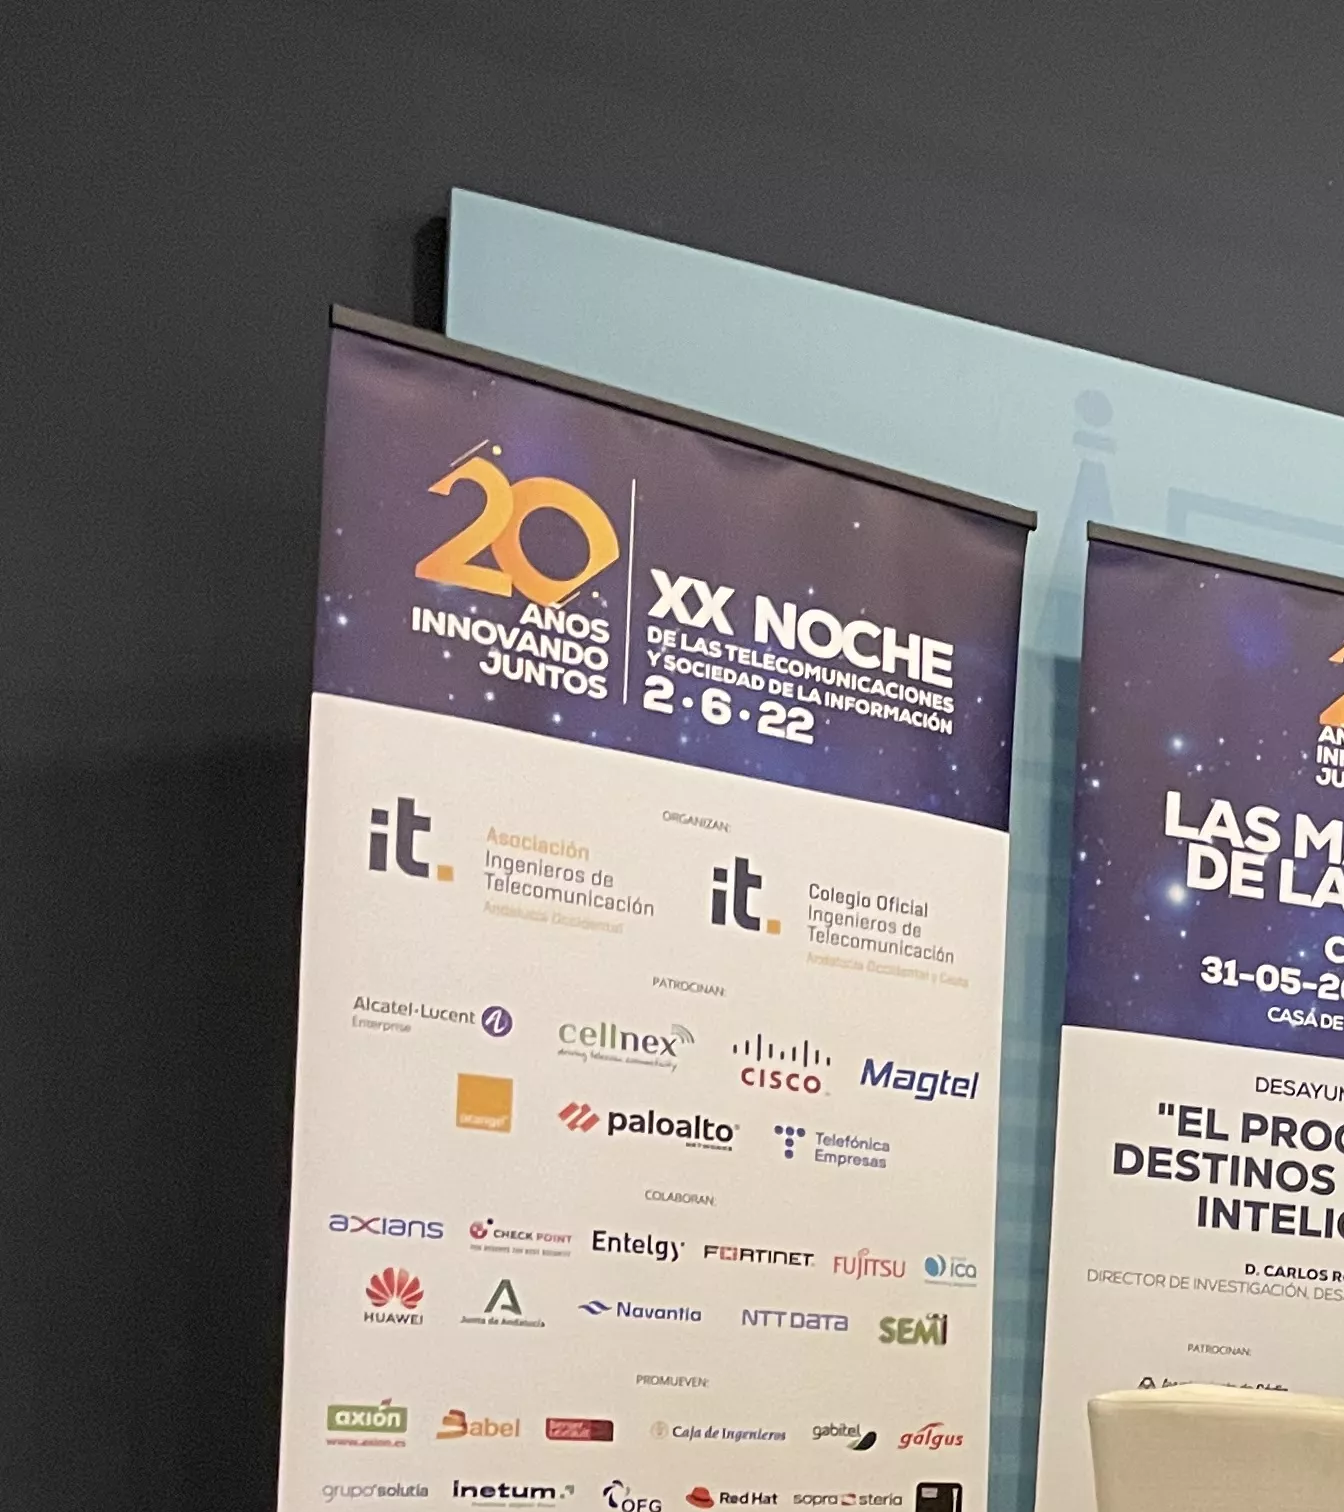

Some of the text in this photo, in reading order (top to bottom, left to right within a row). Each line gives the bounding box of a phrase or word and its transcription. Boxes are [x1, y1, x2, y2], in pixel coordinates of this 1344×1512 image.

[415, 456, 620, 608] 20
[412, 606, 609, 671] INNOVANDO
[519, 601, 611, 645] AÑOS
[648, 568, 954, 688] XX NOCHE
[479, 650, 608, 700] JUNTOS
[647, 626, 955, 713] DE LAS TELECOMUNICACIONES
[646, 648, 954, 735] Y SOCIEDAD DE LA INFORMACIÓN
[1164, 790, 1281, 854] LAS
[486, 827, 591, 860] Asociación
[485, 850, 614, 888] Ingenieros de
[1187, 842, 1264, 900] DE
[484, 872, 655, 917] Telecomunicación
[808, 883, 929, 918] Colegio Oficial
[808, 905, 922, 938] Ingenieros de
[807, 925, 954, 964] Telecomunicación
[1267, 1006, 1318, 1028] CASA
[1321, 1014, 1344, 1031] DE
[558, 1022, 678, 1057] cellnex
[740, 1066, 822, 1093] CISCO
[860, 1058, 979, 1101] Magtel
[607, 1109, 734, 1142] paloalto
[1158, 1102, 1229, 1141] "EL
[815, 1132, 890, 1153] Telefónica
[815, 1149, 887, 1168] Empresas
[1112, 1142, 1336, 1196] DESTINOS
[329, 1214, 444, 1239] axians
[493, 1228, 572, 1243] CHECK POINT
[592, 1230, 679, 1262] Entelgy
[704, 1245, 815, 1267] FORTINET
[833, 1248, 906, 1280] FUJITSU
[1087, 1268, 1166, 1288] DIRECTOR
[1169, 1275, 1190, 1290] DE
[1245, 1264, 1260, 1276] D.
[1263, 1264, 1328, 1281] CARLOS
[364, 1311, 424, 1325] HUAWEI
[616, 1301, 701, 1323] Navantia
[741, 1308, 788, 1328] NTT
[672, 1425, 786, 1442] Caja de Ingenieros
[812, 1422, 862, 1440] gabitel
[897, 1424, 964, 1450] galgus
[719, 1491, 778, 1506] Red Hat
[858, 1492, 903, 1506] steria
